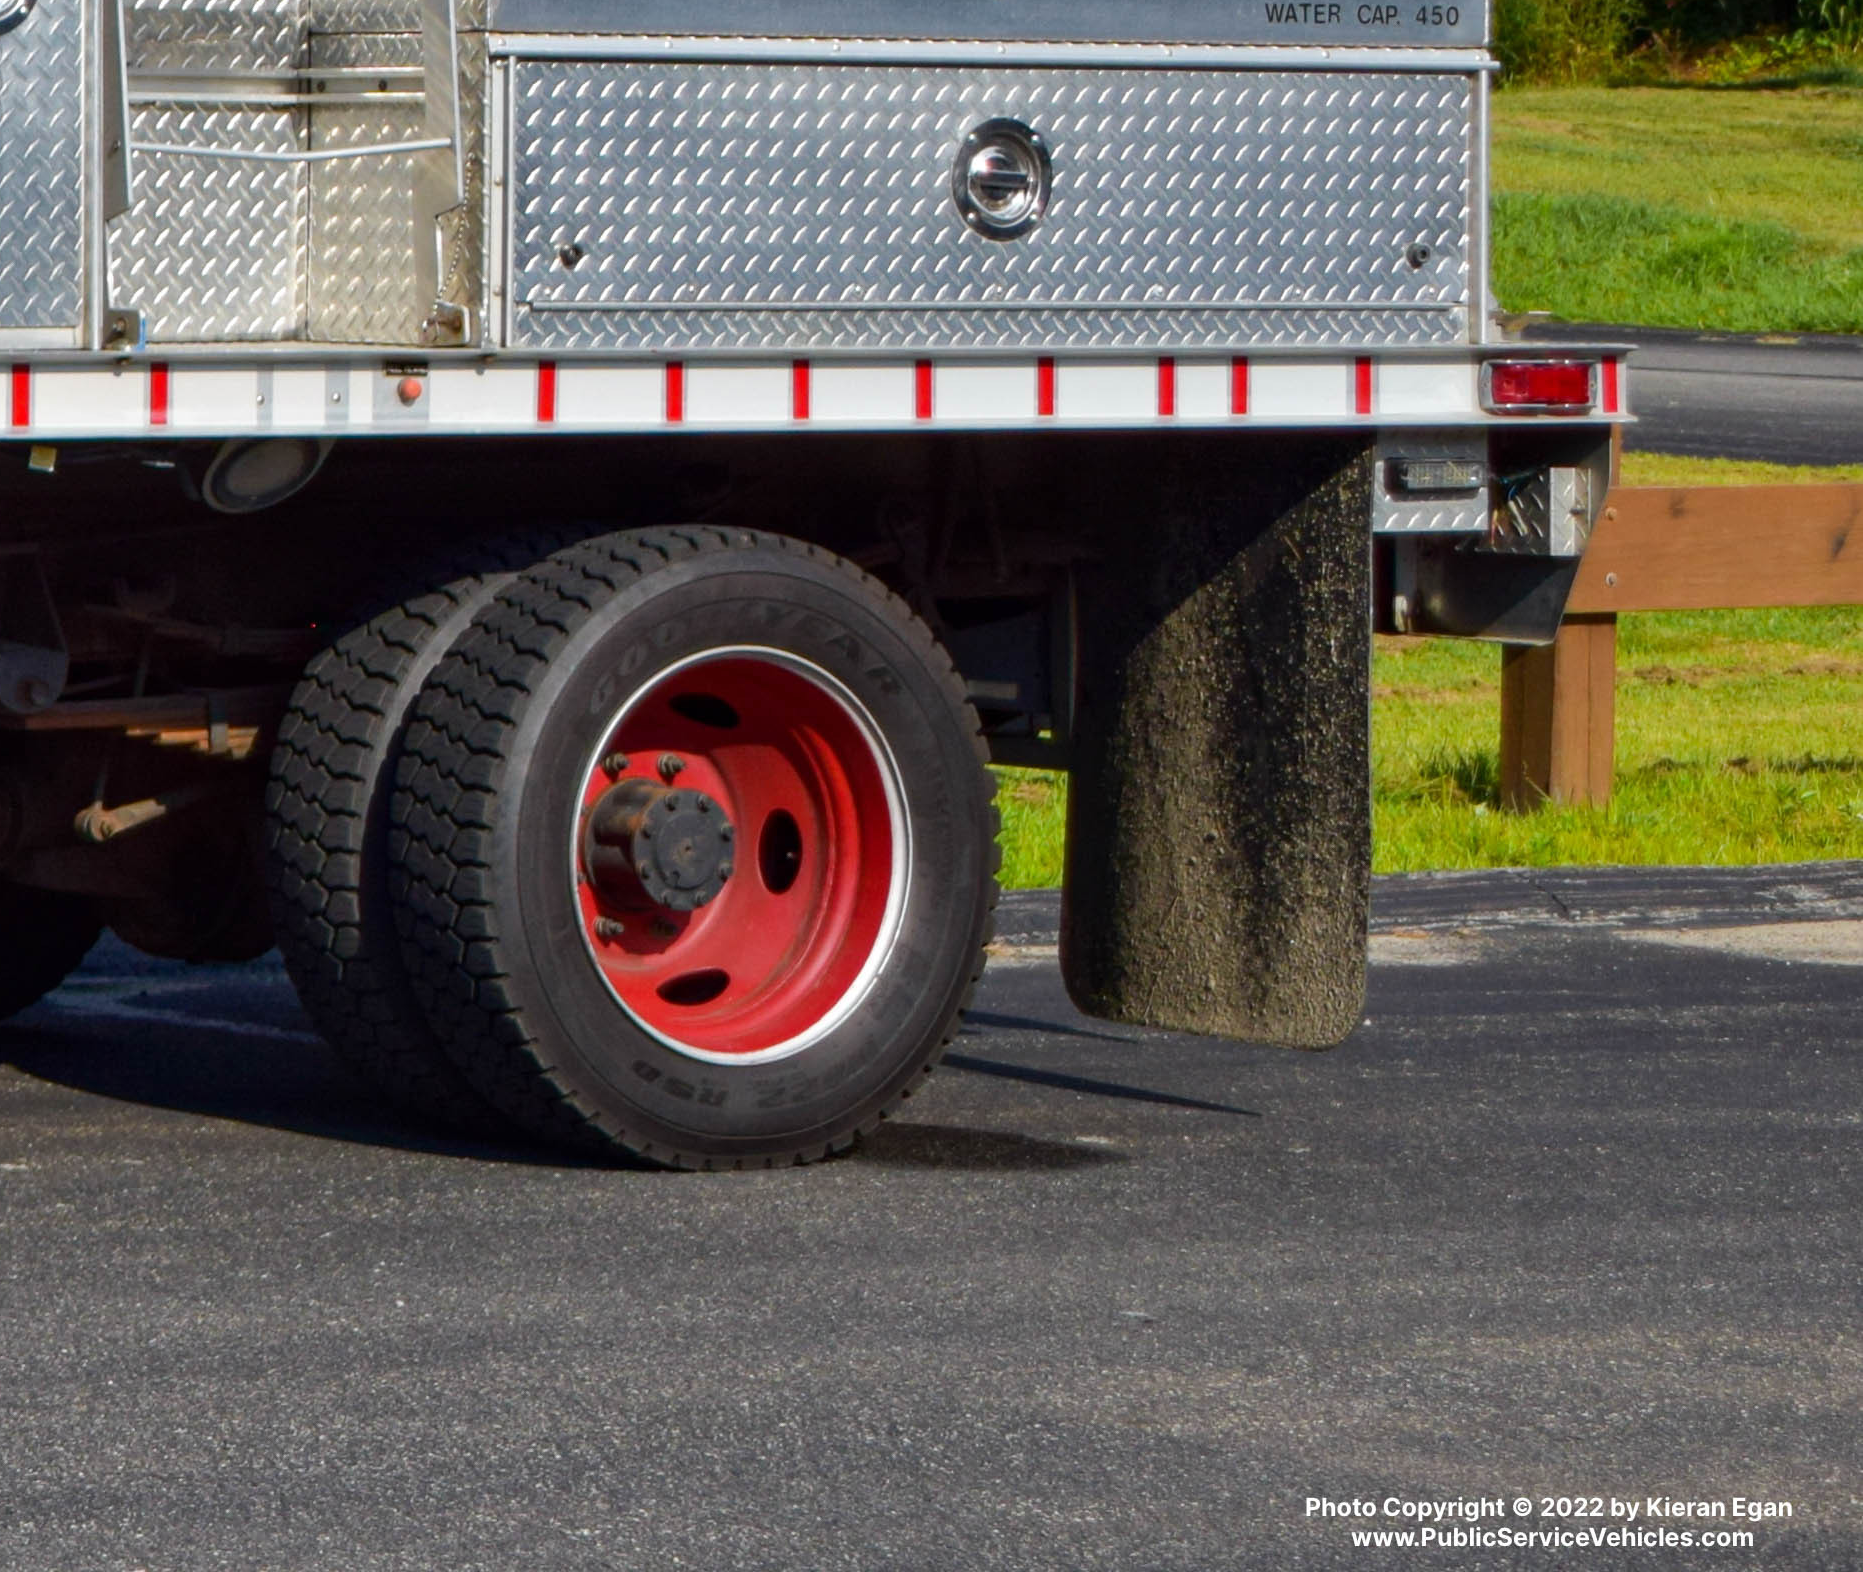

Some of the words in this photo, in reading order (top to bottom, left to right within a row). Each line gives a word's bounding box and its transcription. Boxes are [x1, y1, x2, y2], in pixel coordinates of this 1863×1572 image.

[1265, 3, 1341, 24] WATER
[1357, 4, 1400, 25] CAP.
[1415, 6, 1459, 26] 450
